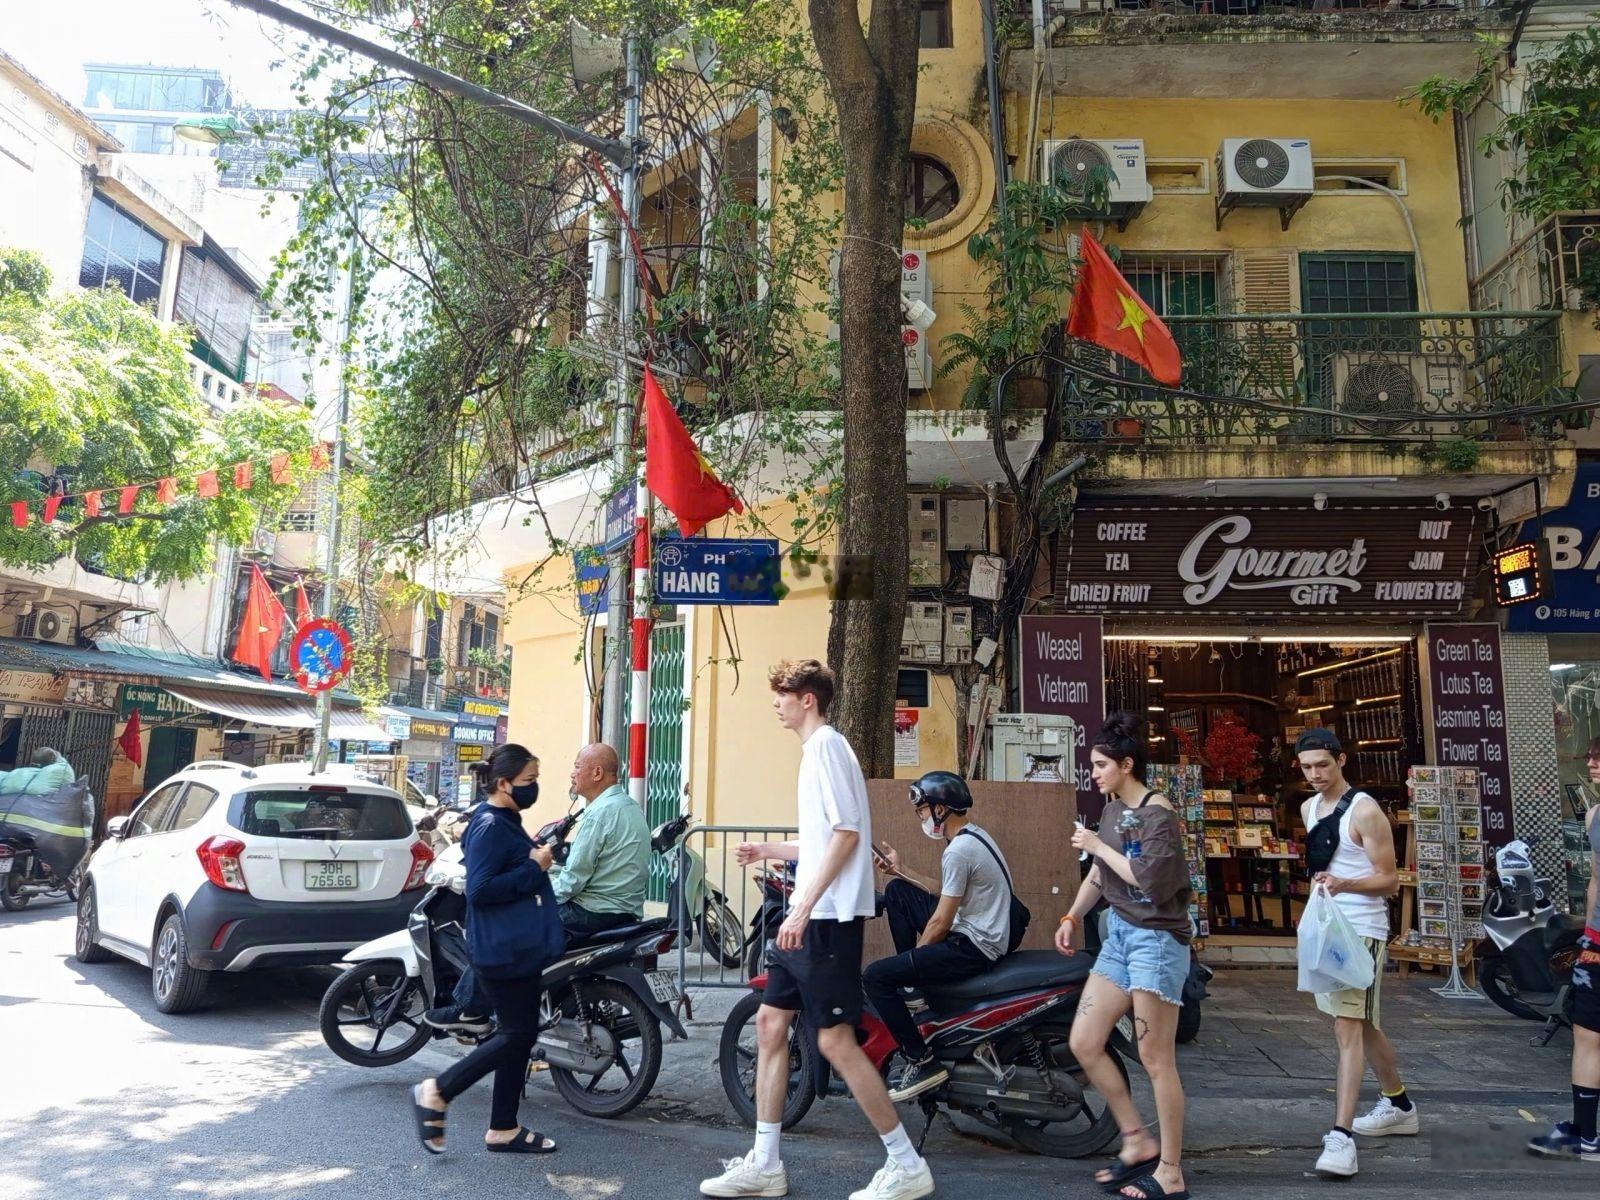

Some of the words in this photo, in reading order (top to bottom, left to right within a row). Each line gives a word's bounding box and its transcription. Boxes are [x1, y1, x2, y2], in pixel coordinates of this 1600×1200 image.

[903, 272, 918, 282] LG
[1096, 522, 1148, 541] COFFEE
[1418, 519, 1452, 540] NUT
[1105, 552, 1130, 571] TEA
[1177, 515, 1368, 606] Gourmet
[1408, 551, 1445, 570] JAM
[662, 567, 720, 594] HÀNG
[1374, 581, 1433, 601] FLOWER
[1434, 581, 1463, 601] TEA
[1069, 583, 1111, 602] DRIED
[1113, 583, 1151, 602] FRUIT
[1290, 584, 1339, 606] Gift
[1553, 608, 1568, 618] 105
[1569, 607, 1591, 620] Hàng
[1036, 631, 1083, 661] Weasel
[1436, 638, 1471, 662] Green
[1472, 638, 1493, 661] Tea
[18, 672, 64, 695] TRANG
[1037, 673, 1089, 704] Vietnam
[1440, 671, 1471, 694] Lotus
[1472, 671, 1493, 694] Tea
[1435, 705, 1481, 728] Jasmine
[1482, 705, 1504, 728] Tea
[454, 726, 478, 740] BOOKING
[478, 729, 495, 741] OFFICE
[1442, 738, 1479, 761] Flower
[1480, 738, 1502, 762] Tea
[1480, 772, 1501, 796] Tea
[1483, 806, 1505, 829] Tea
[320, 863, 343, 874] 30H
[311, 875, 352, 887] 765.66
